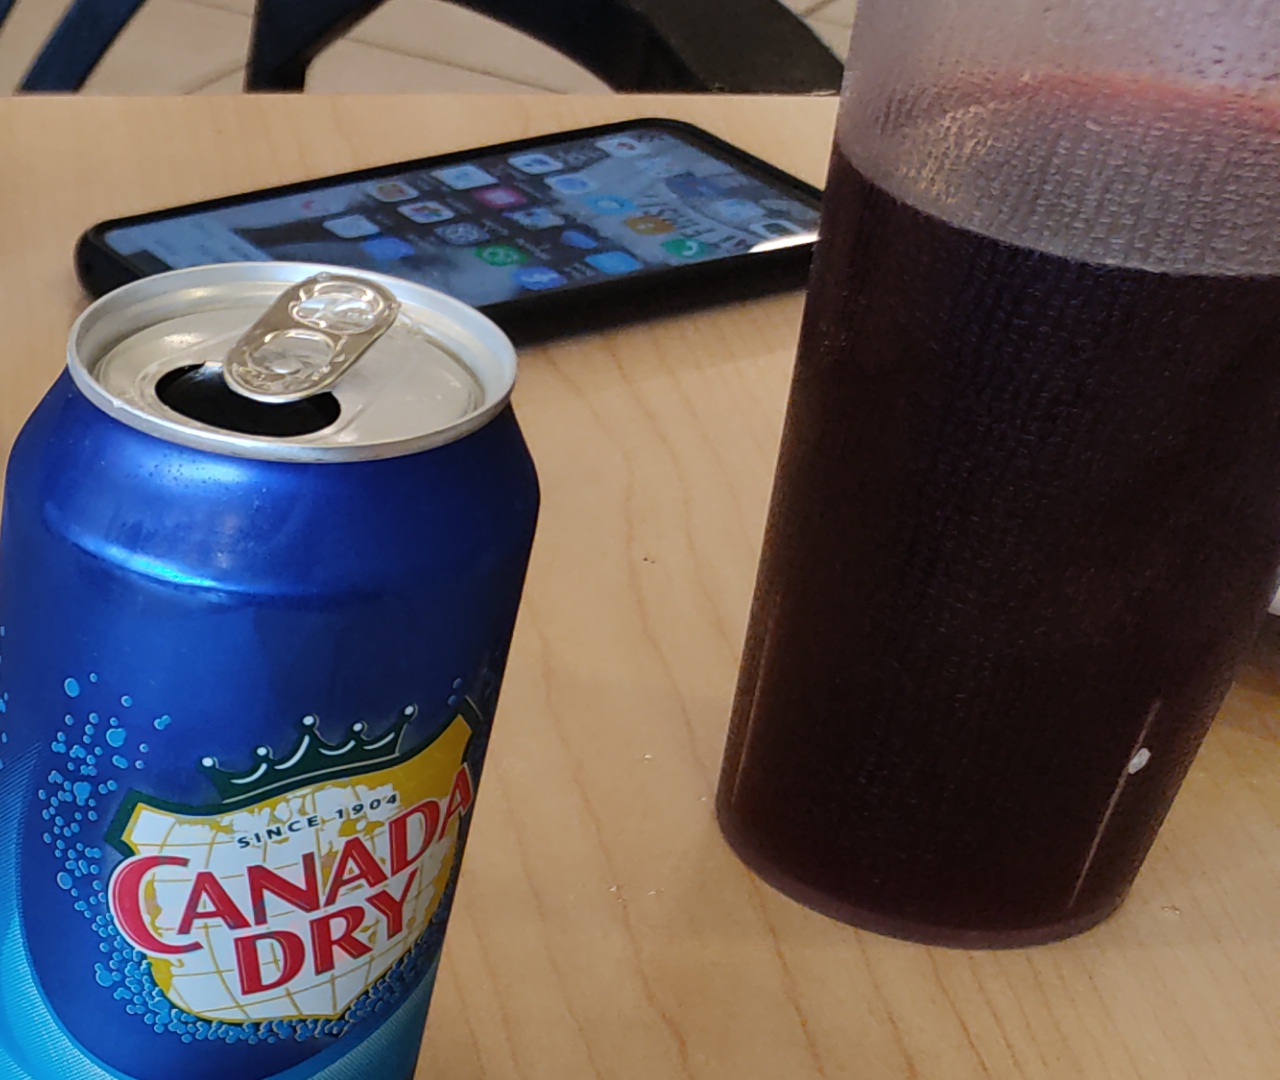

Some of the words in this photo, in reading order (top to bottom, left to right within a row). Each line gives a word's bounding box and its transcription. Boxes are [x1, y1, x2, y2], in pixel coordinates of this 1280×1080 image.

[111, 766, 474, 955] CANADA
[236, 813, 319, 849] SINCE
[333, 793, 398, 819] 1904
[233, 867, 420, 996] DRY
